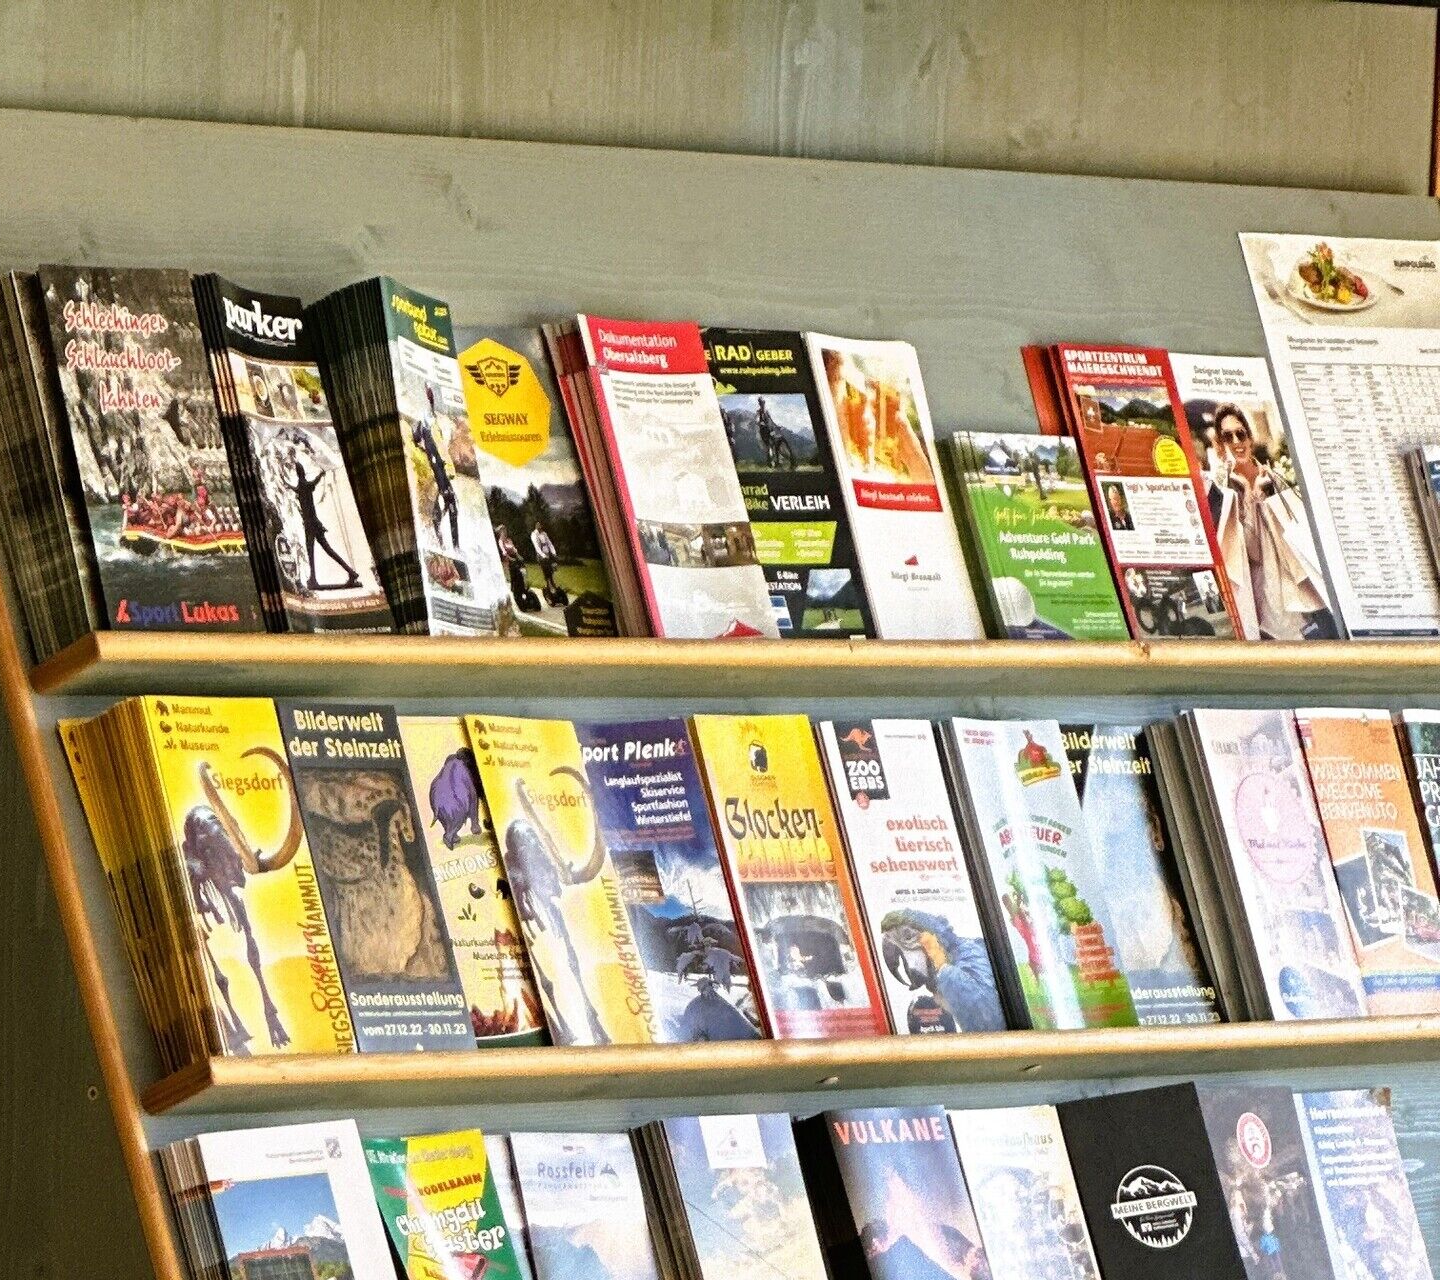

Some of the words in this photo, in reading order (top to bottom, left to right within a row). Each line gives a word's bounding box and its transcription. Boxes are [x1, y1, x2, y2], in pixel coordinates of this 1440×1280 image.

[63, 300, 168, 335] Schlechinger
[223, 296, 302, 341] parker
[597, 328, 677, 349] Dokumentation
[603, 347, 668, 368] Obersalzberg
[715, 344, 750, 362] RAD
[756, 349, 793, 362] GEBER
[1064, 349, 1147, 365] SPORTZENTRUM
[483, 412, 529, 426] SEGWAY
[770, 494, 830, 512] VERLEIH
[180, 599, 239, 624] Lukas
[172, 702, 212, 717] Mammut
[175, 721, 229, 735] Naturkunde
[293, 709, 384, 733] Bilderwelt
[180, 739, 220, 753] Museum
[289, 738, 321, 758] der
[326, 737, 402, 760] Steinzeit
[625, 738, 675, 762] Plenk
[845, 761, 880, 777] ZOO
[1311, 763, 1400, 780] WILLKOMMEN
[211, 769, 284, 796] Siegsdorf
[604, 771, 682, 788] Langlaufspezialist
[849, 775, 885, 791] EBBS
[641, 785, 685, 798] Skiservice
[1317, 782, 1382, 799] WELCOME
[631, 798, 689, 813] Sportfashion
[635, 811, 692, 825] Winterstiefel
[724, 797, 824, 841] Glocken-
[886, 815, 948, 832] exotisch
[895, 836, 953, 854] tierisch
[870, 855, 960, 874] sehenswert
[350, 990, 464, 1009] Sonderausstellung
[833, 1116, 946, 1146] VULKANE
[537, 1160, 596, 1180] Rossfeld
[1114, 1202, 1144, 1216] MEINE
[1146, 1194, 1195, 1211] BERGWELT
